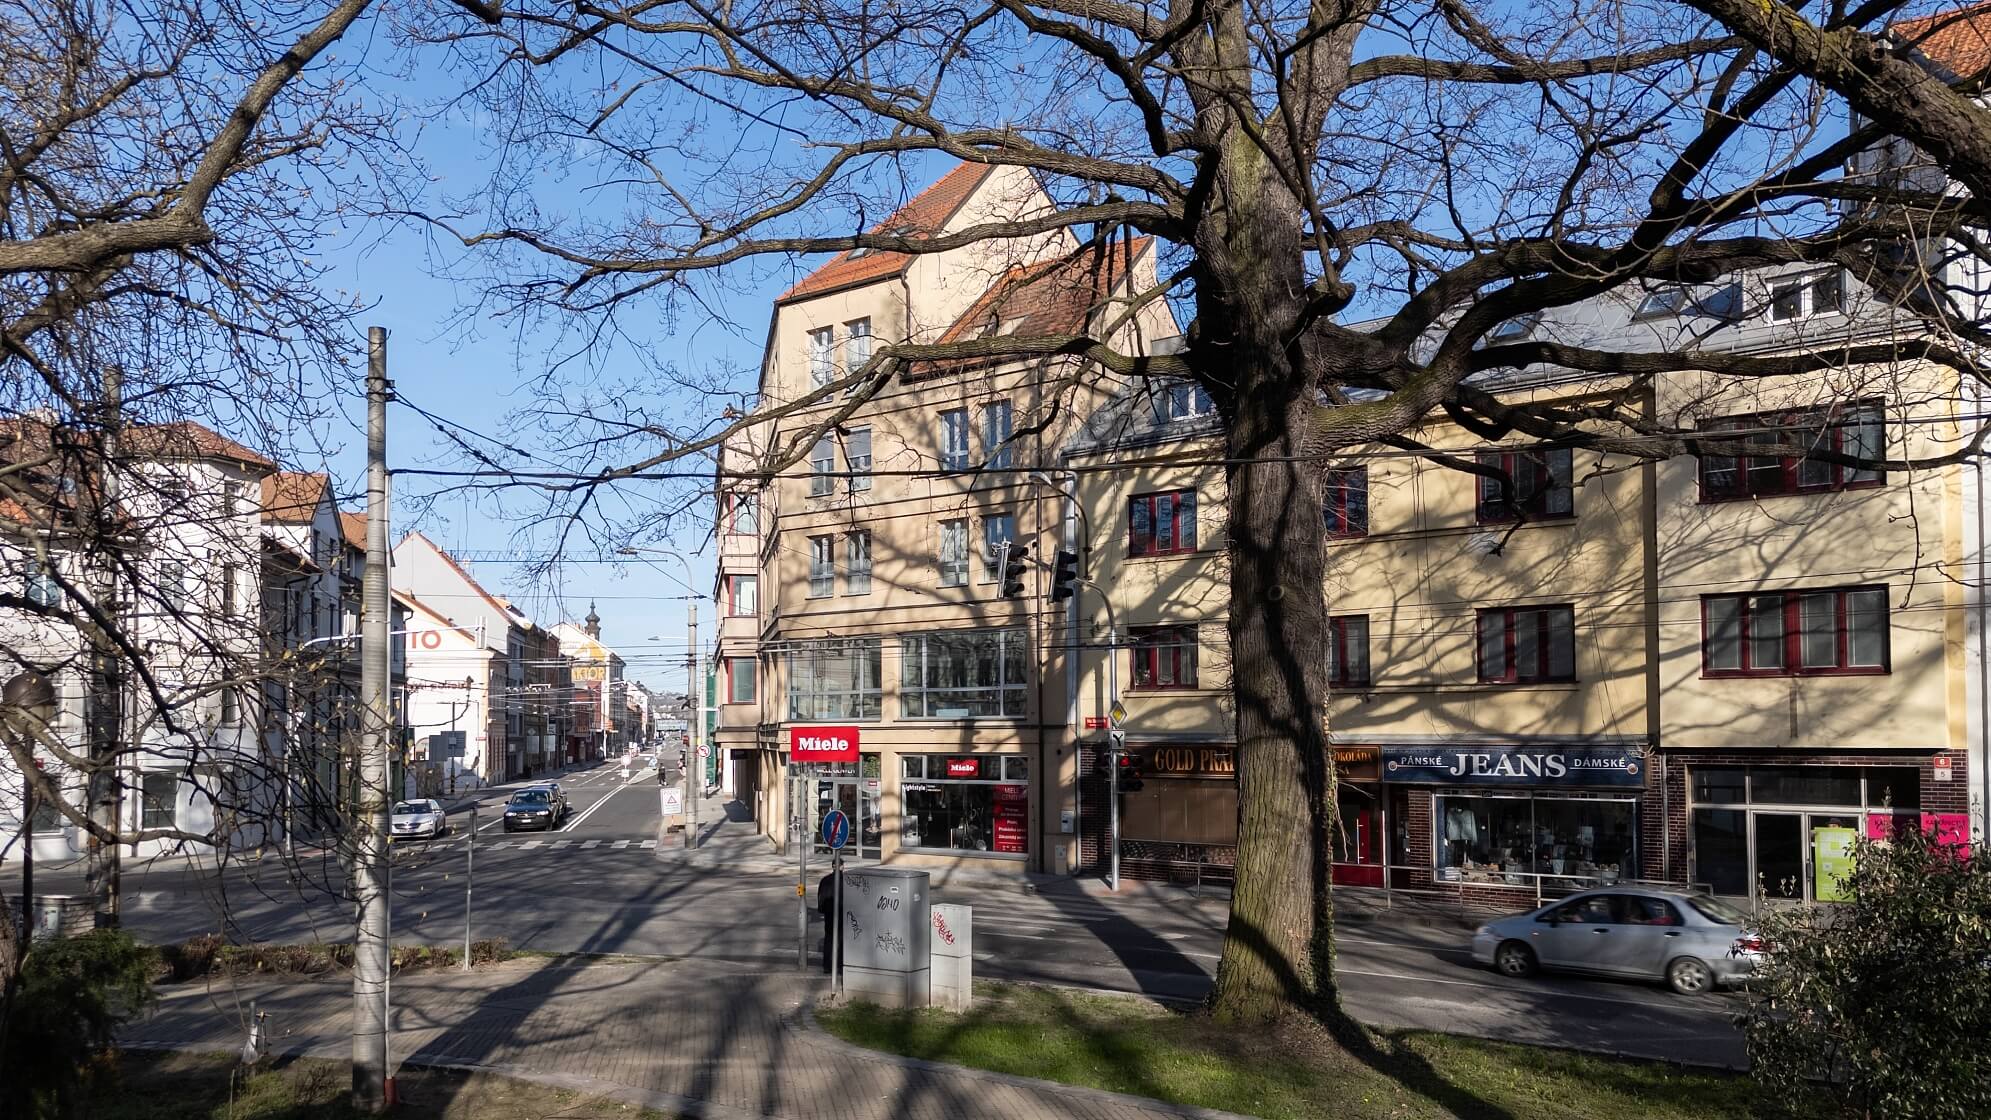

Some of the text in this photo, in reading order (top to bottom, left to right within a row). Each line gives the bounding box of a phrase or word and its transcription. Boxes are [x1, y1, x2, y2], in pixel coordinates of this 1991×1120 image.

[798, 737, 849, 751] Miele
[1155, 749, 1194, 771] GOLD
[1401, 754, 1626, 777] PÁNSKÉ JEANS DÁMSKÉ
